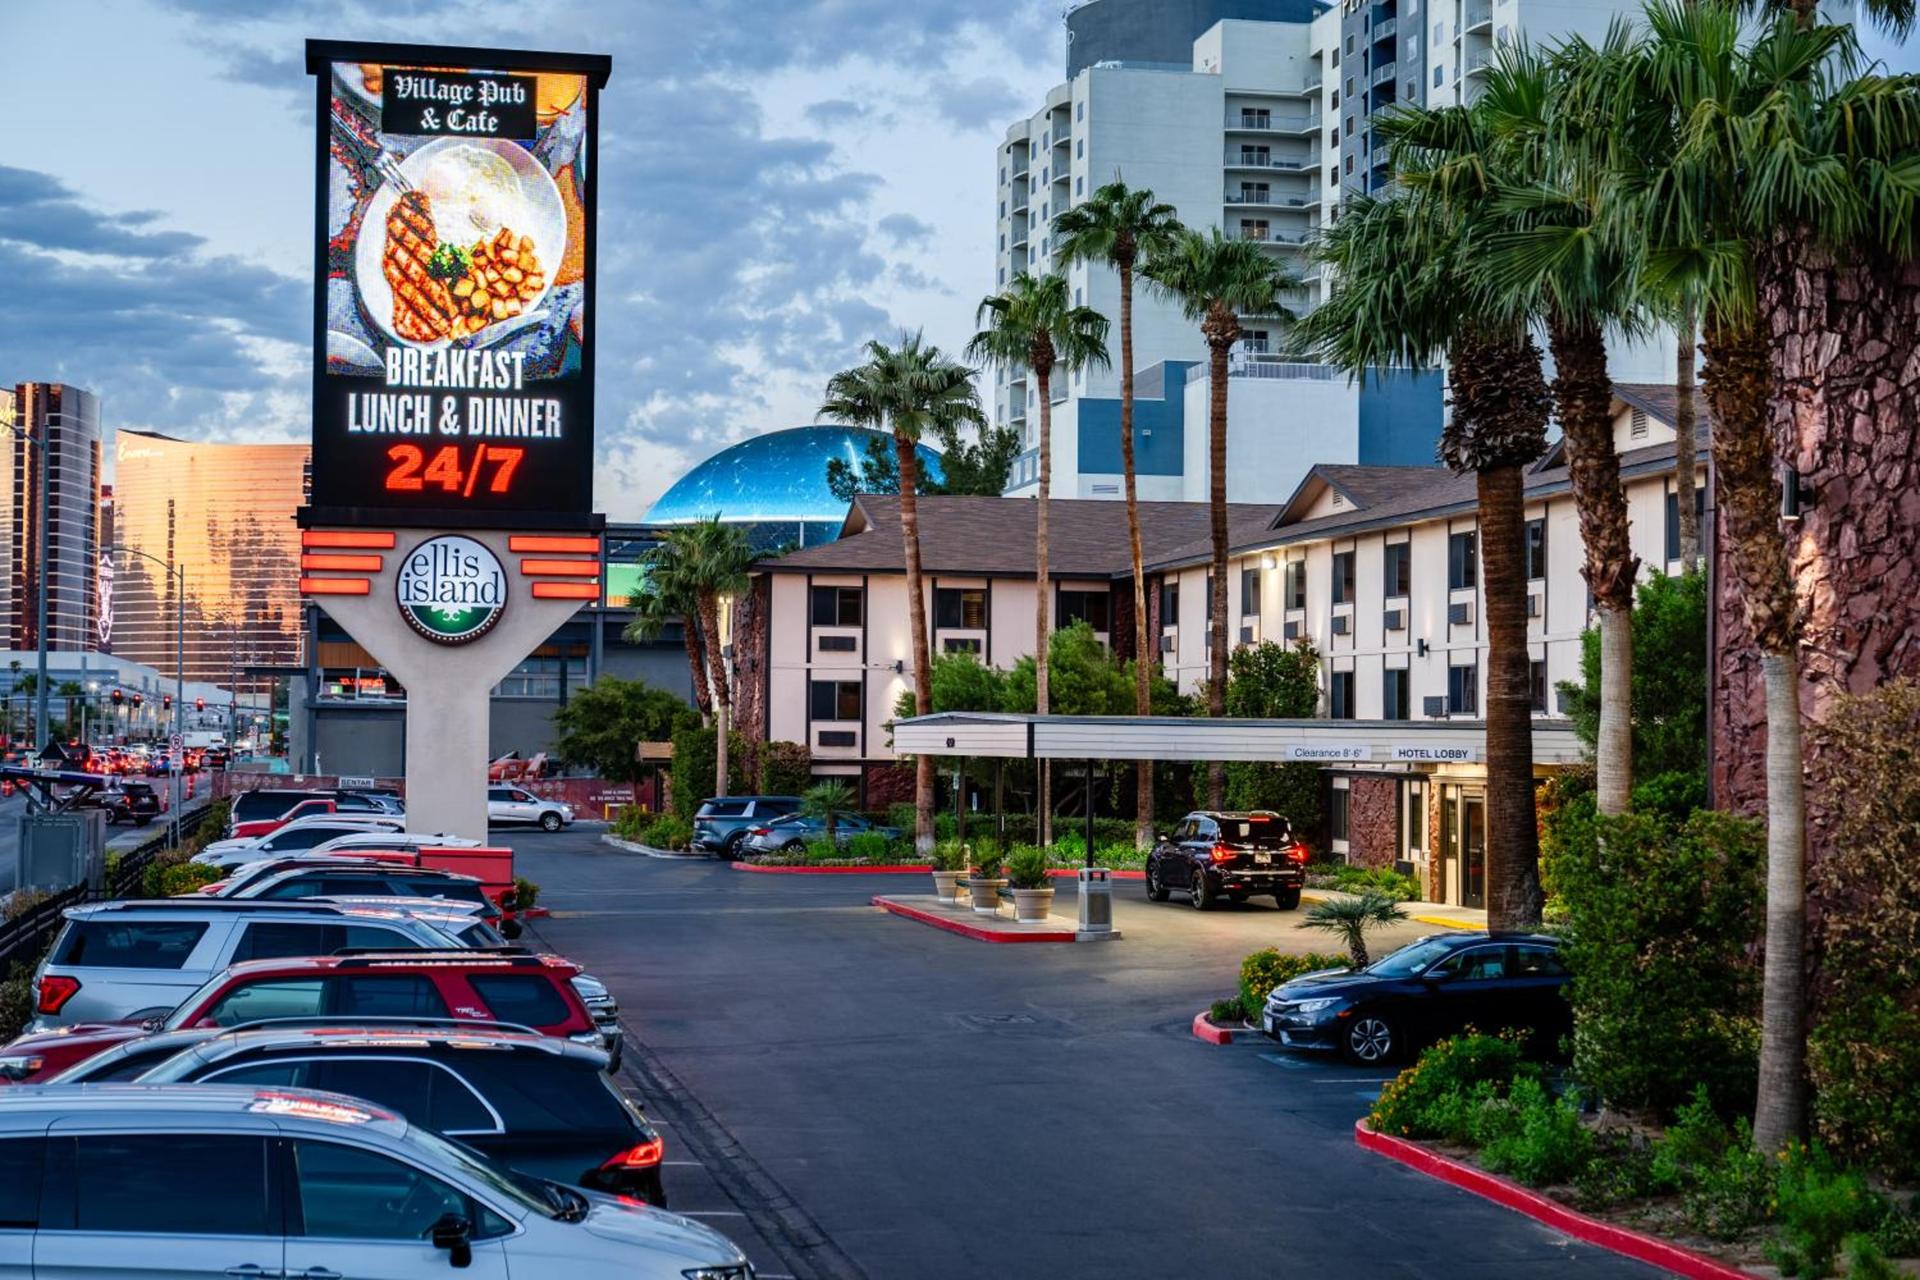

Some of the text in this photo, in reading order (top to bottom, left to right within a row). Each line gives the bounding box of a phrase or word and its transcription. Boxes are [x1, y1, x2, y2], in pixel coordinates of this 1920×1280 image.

[394, 75, 526, 106] Village Pub
[420, 107, 498, 132] & Cafe
[385, 347, 527, 390] BREAKFAST
[347, 393, 562, 438] LUNCH & DINNER
[385, 443, 525, 497] 24/7
[410, 543, 480, 578] ellis
[402, 570, 501, 605] island
[1294, 748, 1341, 758] Clearance
[1398, 749, 1469, 759] HOTEL LOBBY
